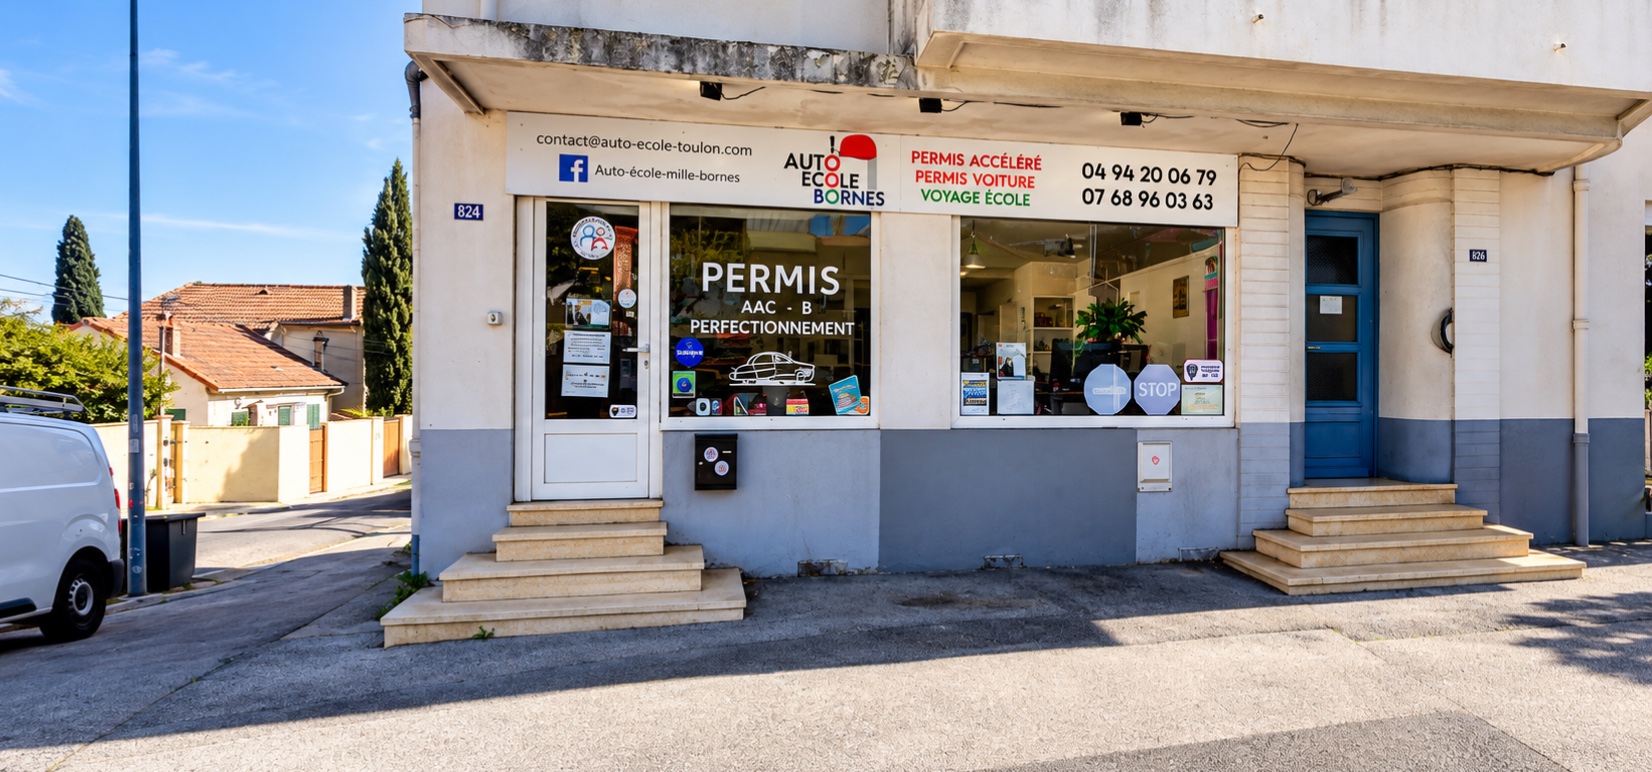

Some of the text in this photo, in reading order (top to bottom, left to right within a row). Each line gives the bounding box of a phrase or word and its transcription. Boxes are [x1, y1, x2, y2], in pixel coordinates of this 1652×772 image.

[537, 134, 752, 157] contact@auto-ecole-toulon.com
[784, 152, 841, 172] AUTO
[911, 150, 1042, 171] PERMIS ACCÉLÉRÉ
[594, 164, 740, 184] Auto-école-mille-bornes
[801, 171, 860, 189] ECOLE
[915, 169, 1036, 190] PERMIS VOITURE
[1081, 162, 1217, 187] 04 94 20 06 79
[814, 188, 885, 207] BORNES
[920, 188, 1031, 207] VOYAGE ÉCOLE
[1081, 187, 1214, 211] 07 68 96 03 63
[457, 204, 481, 219] 824
[1472, 250, 1486, 260] 826
[702, 261, 840, 296] PERMIS
[740, 300, 776, 315] AAC
[801, 300, 813, 315] B
[690, 319, 855, 336] PERFECTIONNEMENT
[1138, 382, 1177, 397] STOP
